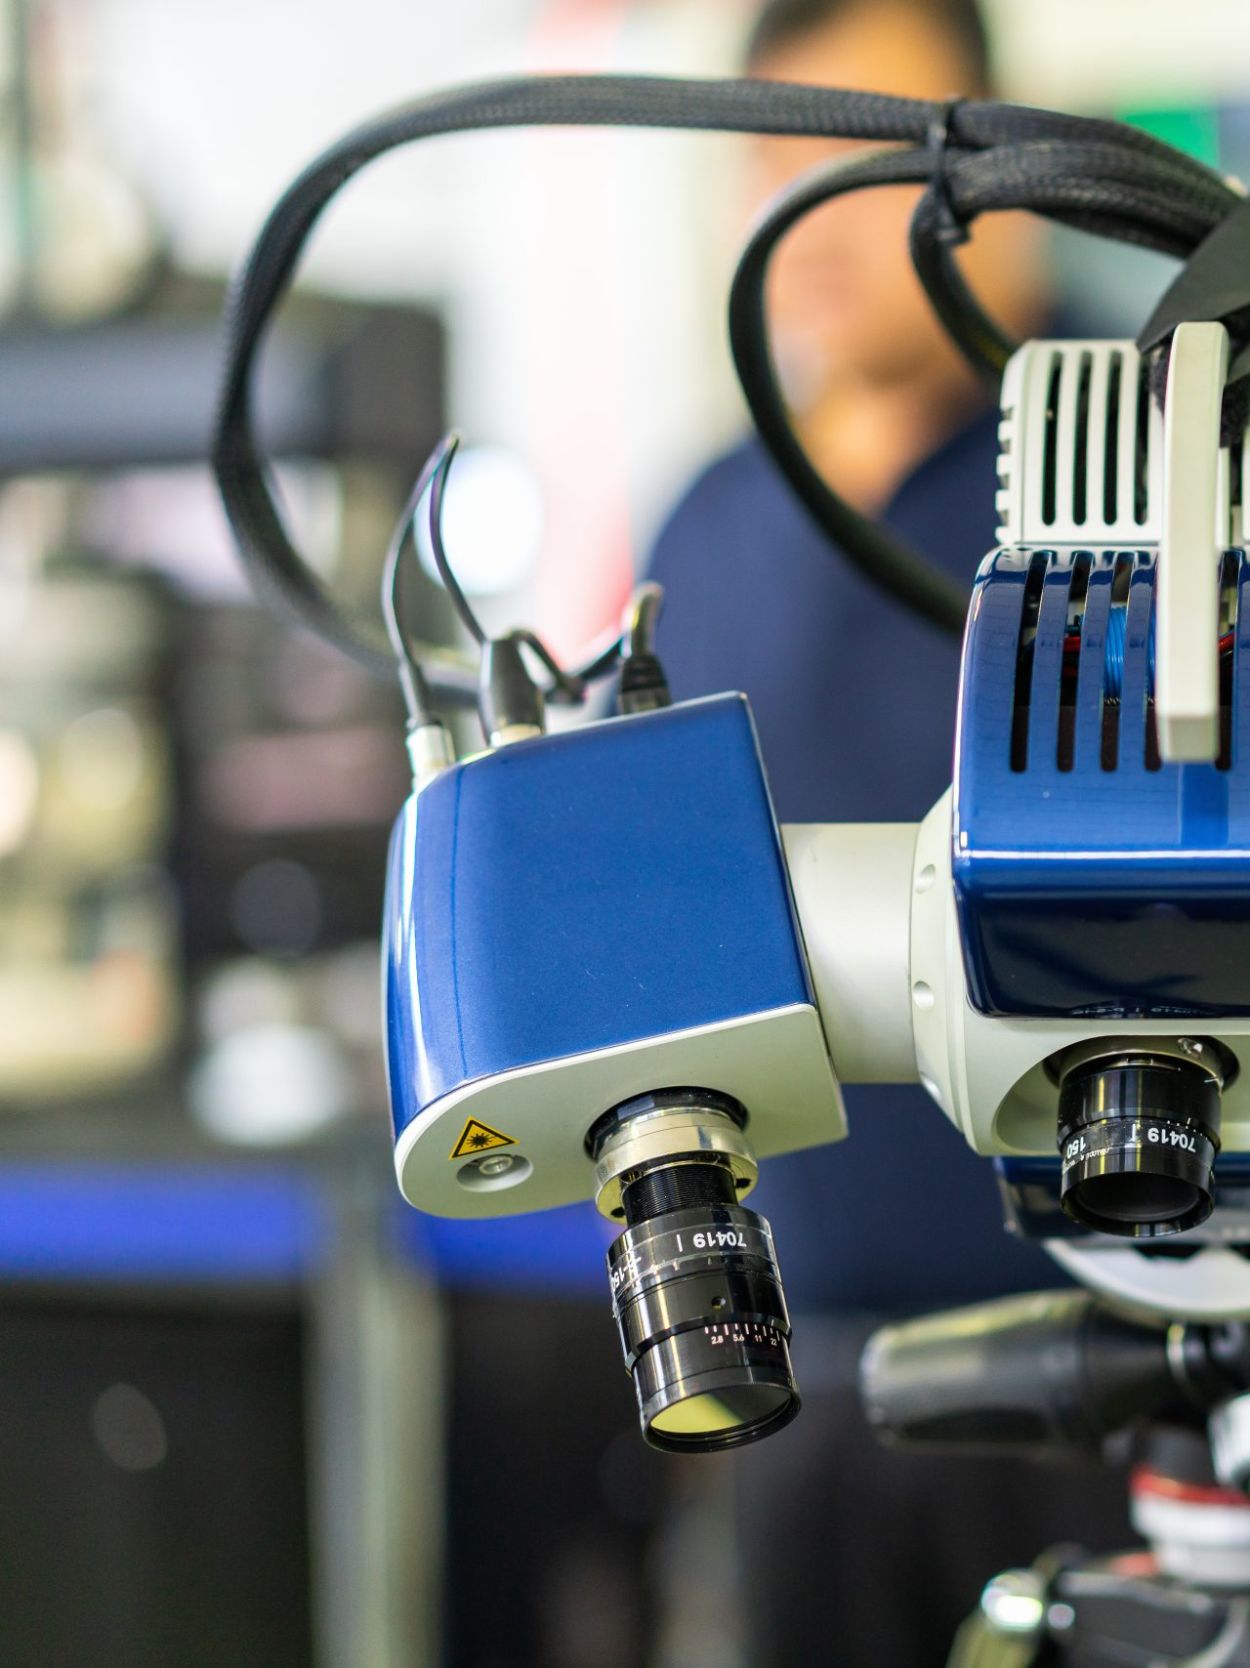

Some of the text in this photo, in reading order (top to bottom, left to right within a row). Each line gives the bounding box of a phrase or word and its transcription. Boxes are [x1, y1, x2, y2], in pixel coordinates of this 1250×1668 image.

[1066, 1136, 1087, 1159] 150
[1147, 1127, 1196, 1153] 70419
[693, 1231, 747, 1249] 70419
[711, 1335, 724, 1345] 2.8
[732, 1333, 745, 1342] 5.6
